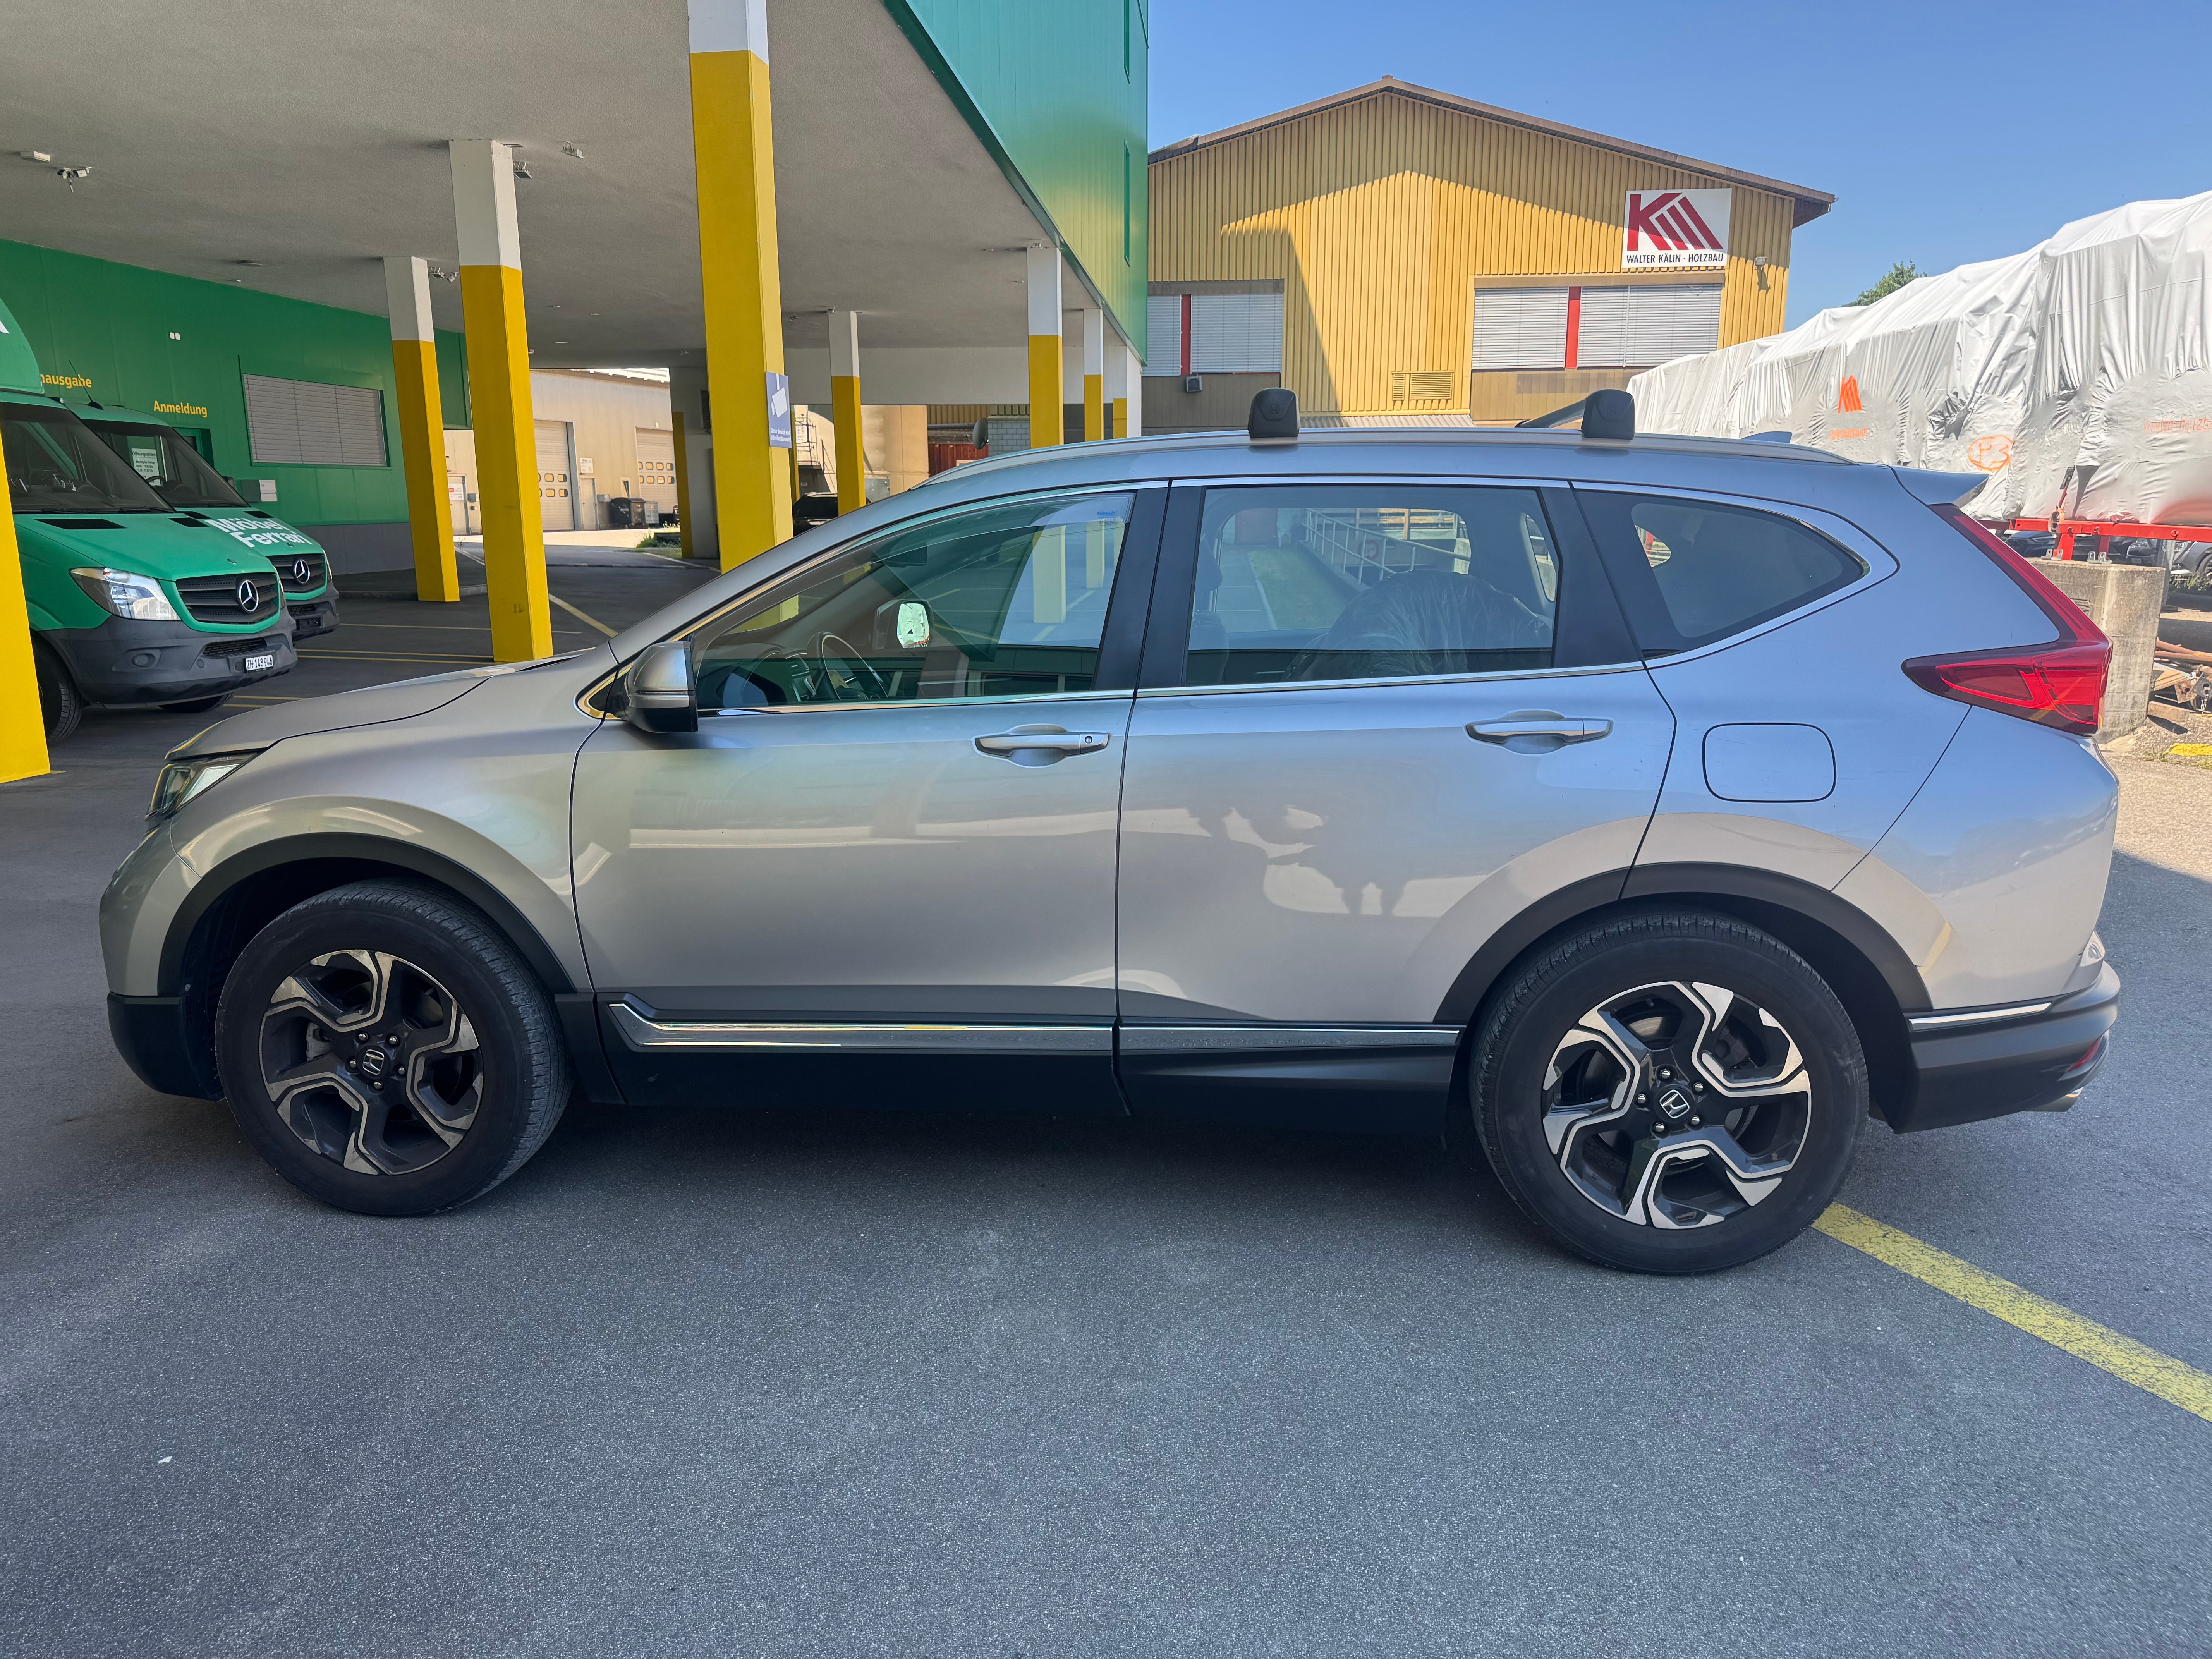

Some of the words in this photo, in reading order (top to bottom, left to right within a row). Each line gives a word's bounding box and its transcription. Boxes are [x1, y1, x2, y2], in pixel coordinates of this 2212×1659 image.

[1627, 255, 1655, 264] WALTER
[1659, 253, 1681, 263] KÄLIN
[1688, 253, 1723, 263] HOLZBAU
[154, 400, 208, 418] Anmeldung
[204, 518, 290, 532] Möbel
[229, 531, 313, 548] Ferrari
